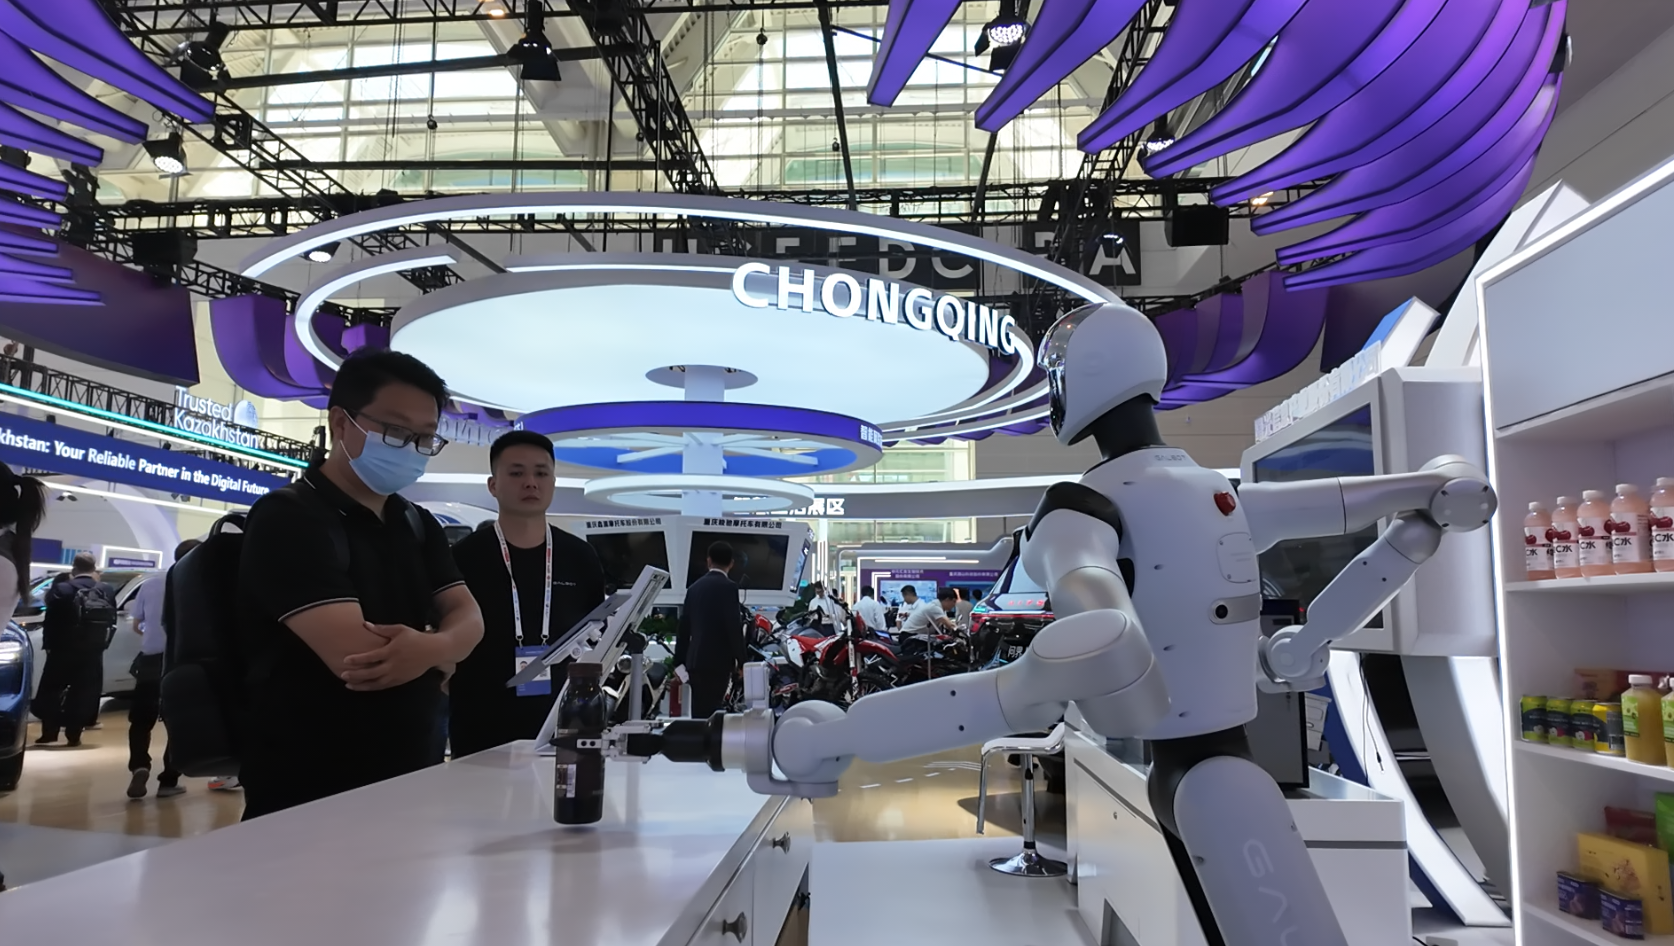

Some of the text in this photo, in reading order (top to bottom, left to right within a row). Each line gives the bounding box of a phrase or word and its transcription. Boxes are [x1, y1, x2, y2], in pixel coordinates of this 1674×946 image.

[732, 262, 1017, 355] CHONGQING
[175, 385, 233, 421] Trusted
[174, 407, 259, 449] Kazakhstan
[54, 440, 86, 460] Your
[88, 447, 137, 470] Reliable
[138, 458, 180, 478] Partner
[180, 466, 192, 481] in
[193, 470, 210, 485] the
[211, 473, 241, 492] Digital
[242, 480, 270, 495] Future
